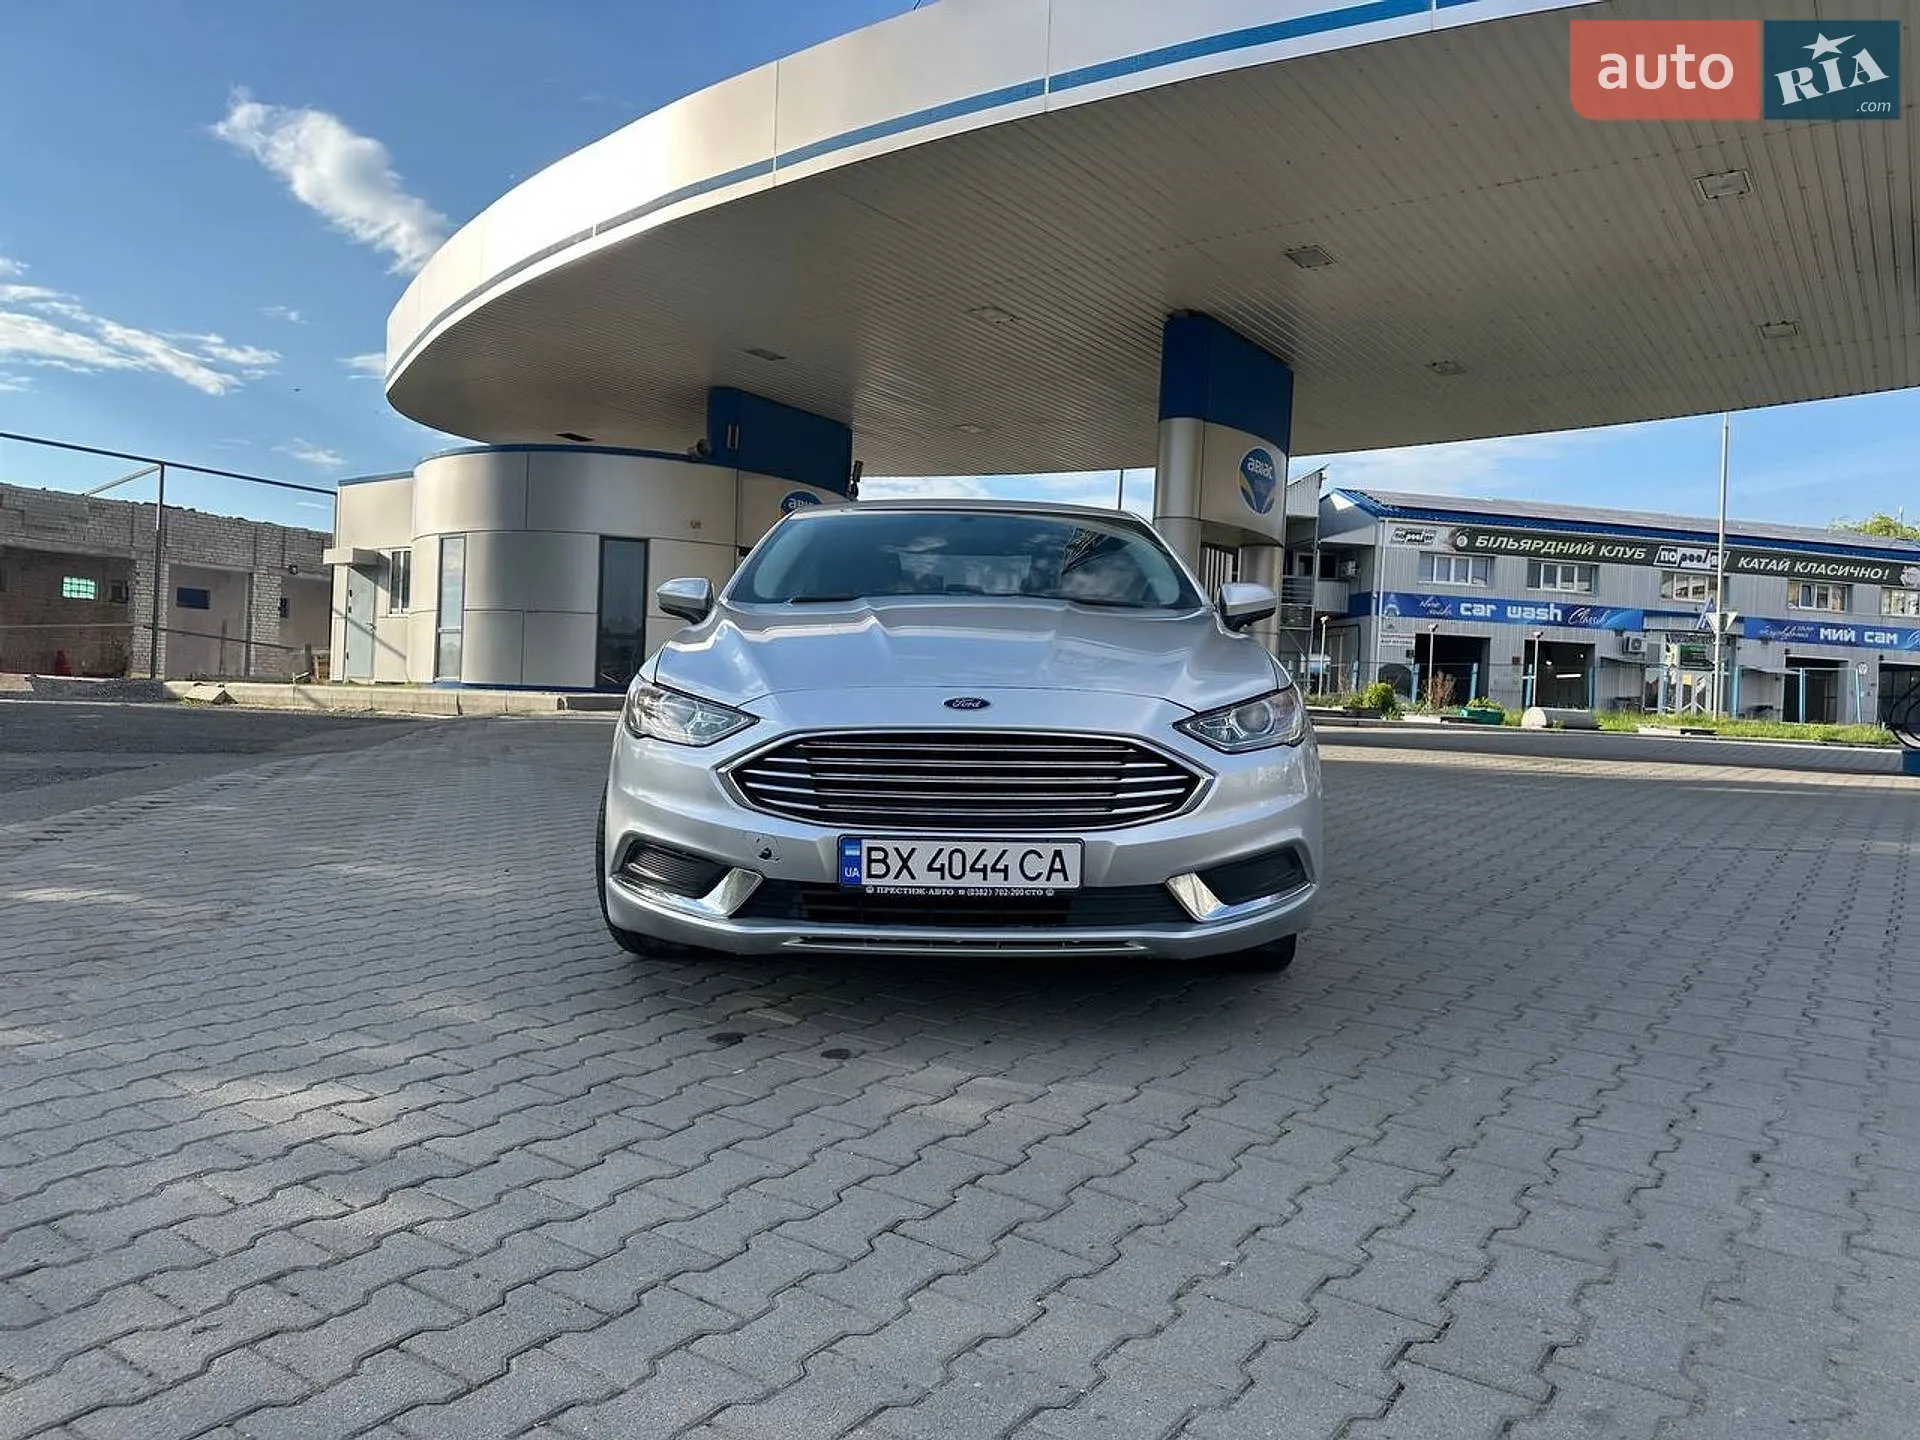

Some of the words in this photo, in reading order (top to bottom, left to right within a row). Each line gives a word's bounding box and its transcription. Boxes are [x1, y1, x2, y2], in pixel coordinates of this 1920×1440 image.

[1475, 534, 1595, 556] БІЛЬЯРДНИЙ
[1599, 545, 1648, 560] КЛУБ
[1738, 556, 1791, 571] КАТАЙ
[1794, 561, 1890, 580] КЛАСИЧНО!
[1460, 603, 1497, 617] car
[1506, 603, 1562, 621] wash
[844, 867, 860, 878] UA
[866, 846, 917, 880] BX
[926, 847, 1009, 882] 4044
[1018, 848, 1069, 882] CA
